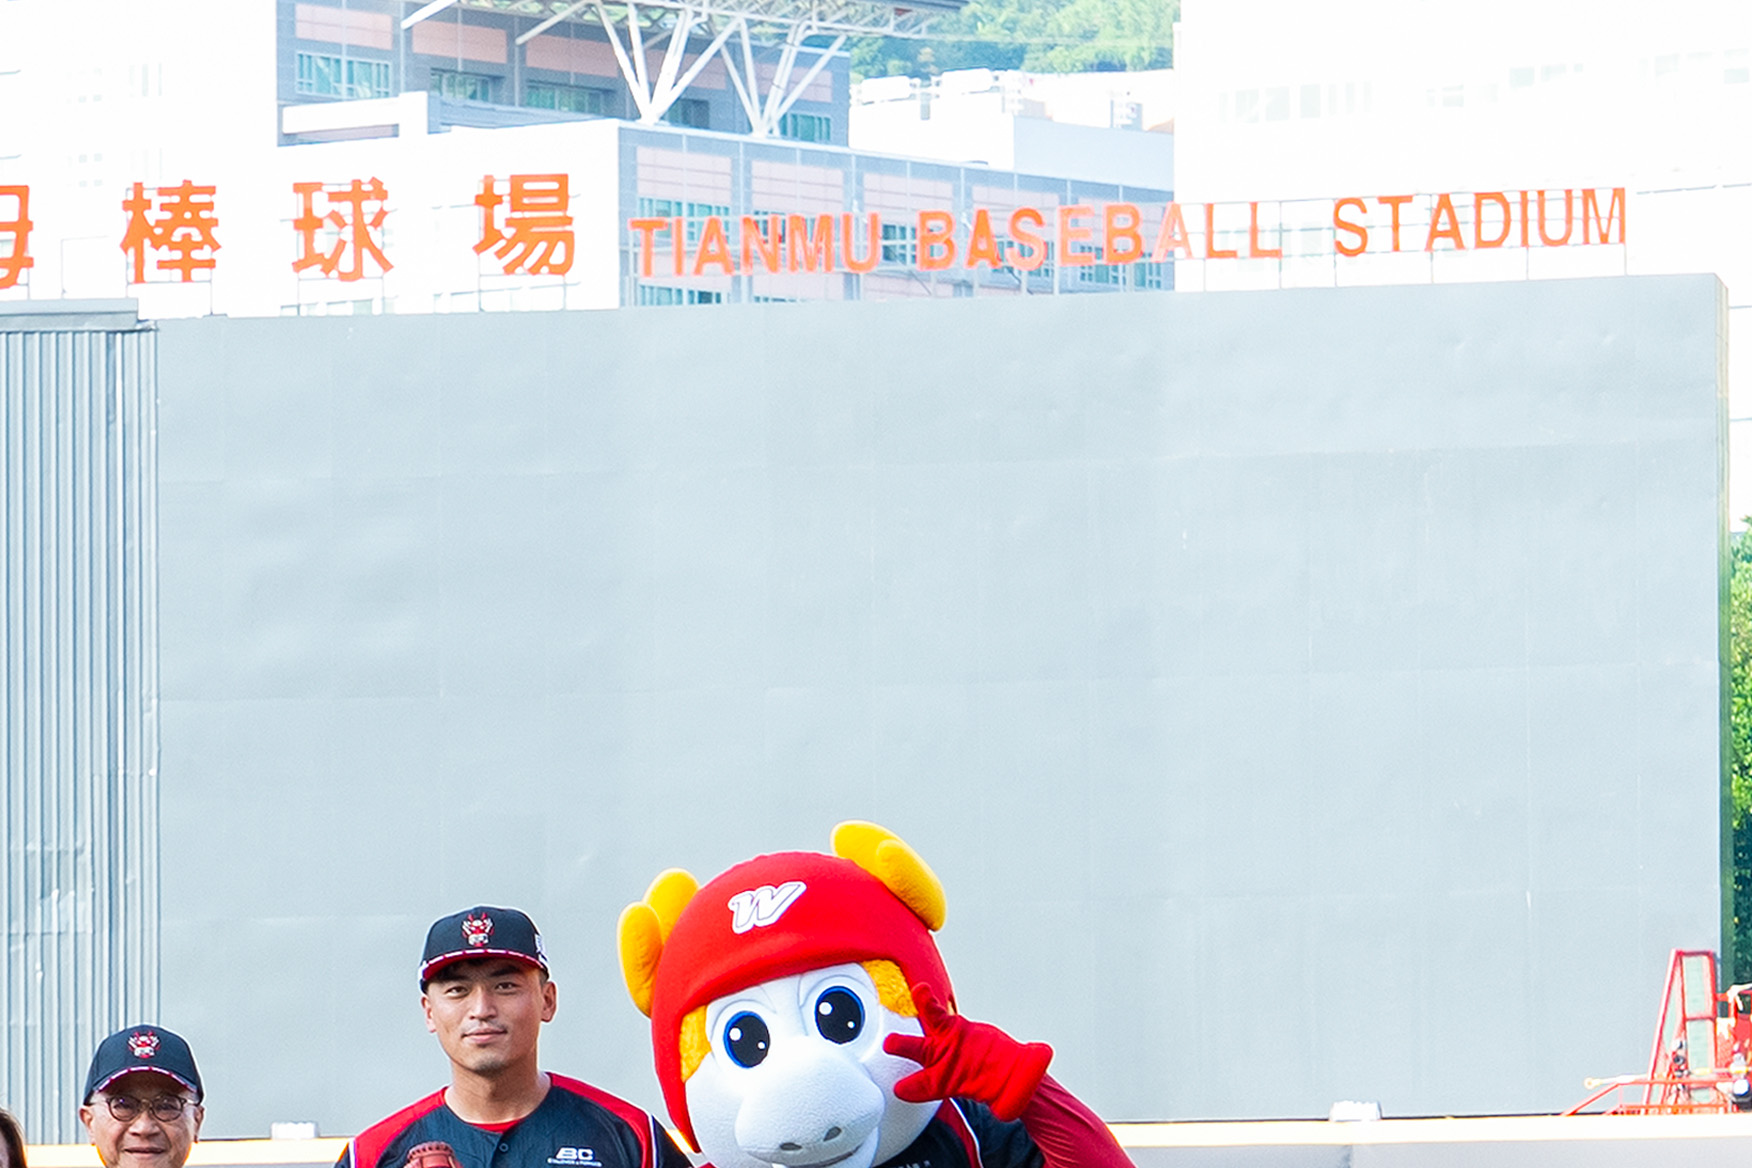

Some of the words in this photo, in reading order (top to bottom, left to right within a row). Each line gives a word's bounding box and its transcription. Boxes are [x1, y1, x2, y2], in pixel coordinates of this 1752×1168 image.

[628, 211, 881, 277] TIANMU
[915, 202, 1283, 272] BASEBALL
[1333, 188, 1625, 257] STADIUM
[728, 881, 806, 934] W
